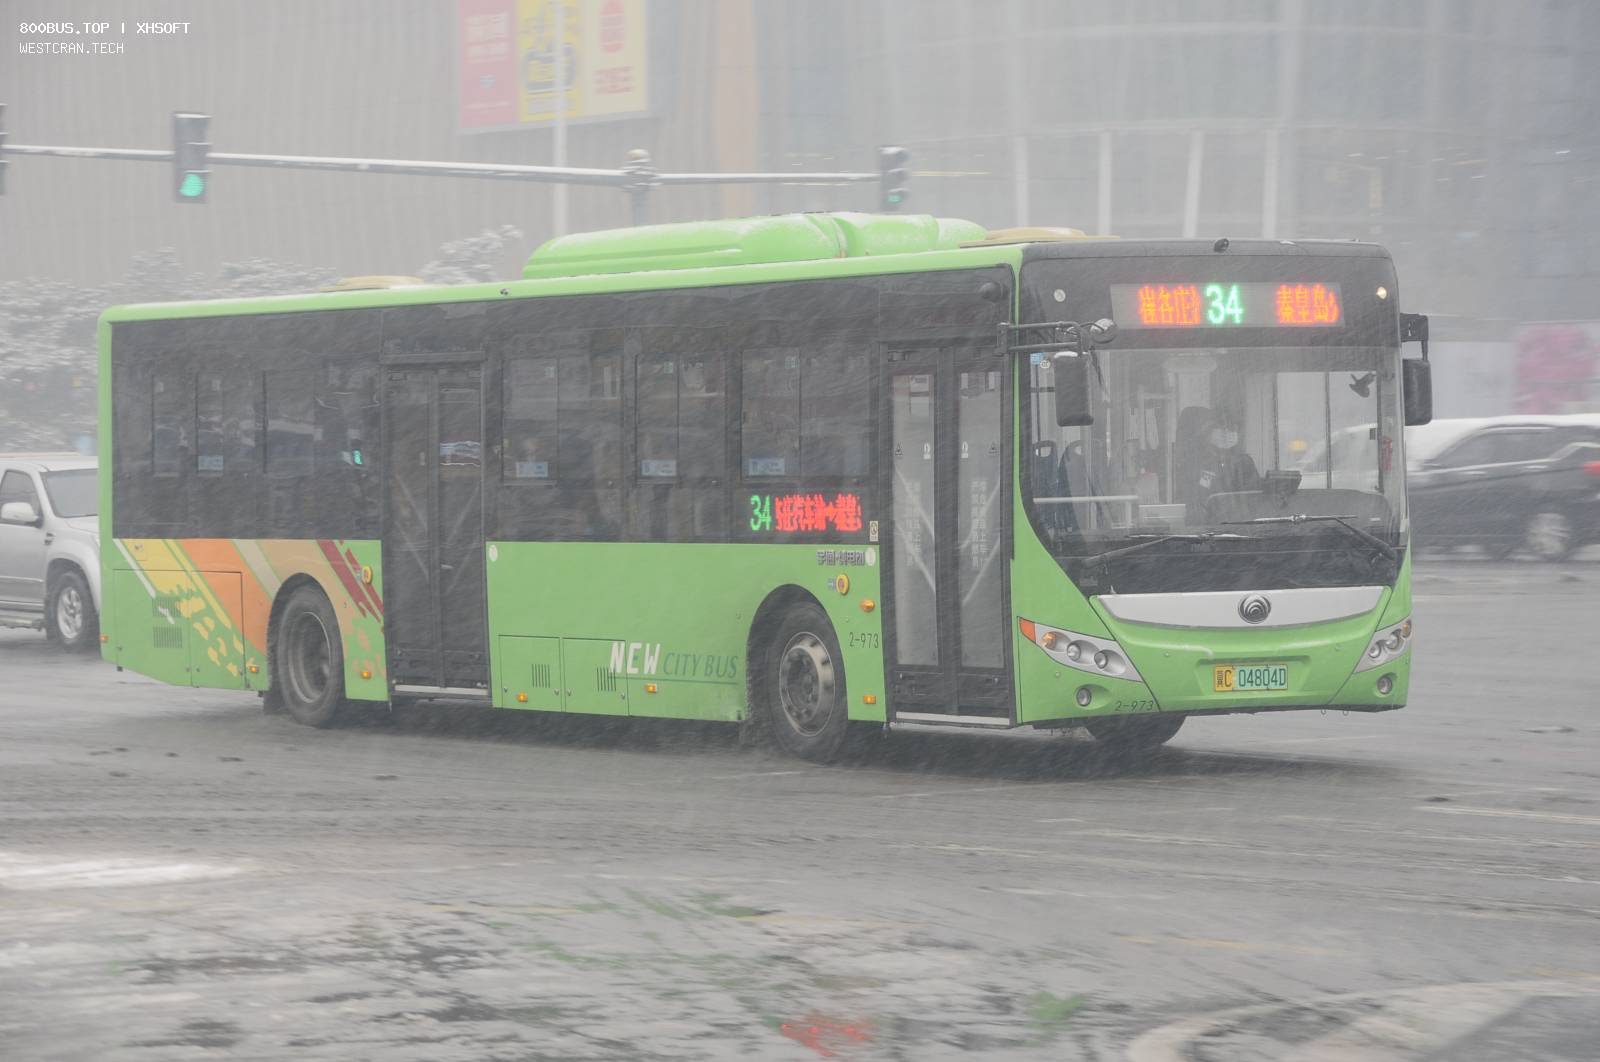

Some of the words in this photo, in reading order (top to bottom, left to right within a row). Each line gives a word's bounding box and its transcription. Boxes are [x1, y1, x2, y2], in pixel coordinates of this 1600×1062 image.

[1205, 284, 1243, 324] 34
[750, 494, 772, 531] 34
[849, 631, 879, 649] 2-973
[609, 640, 661, 675] NEW
[663, 652, 702, 677] CITY
[704, 654, 738, 679] BUS
[1238, 668, 1287, 688] 04804D
[1114, 700, 1154, 712] 2-973
